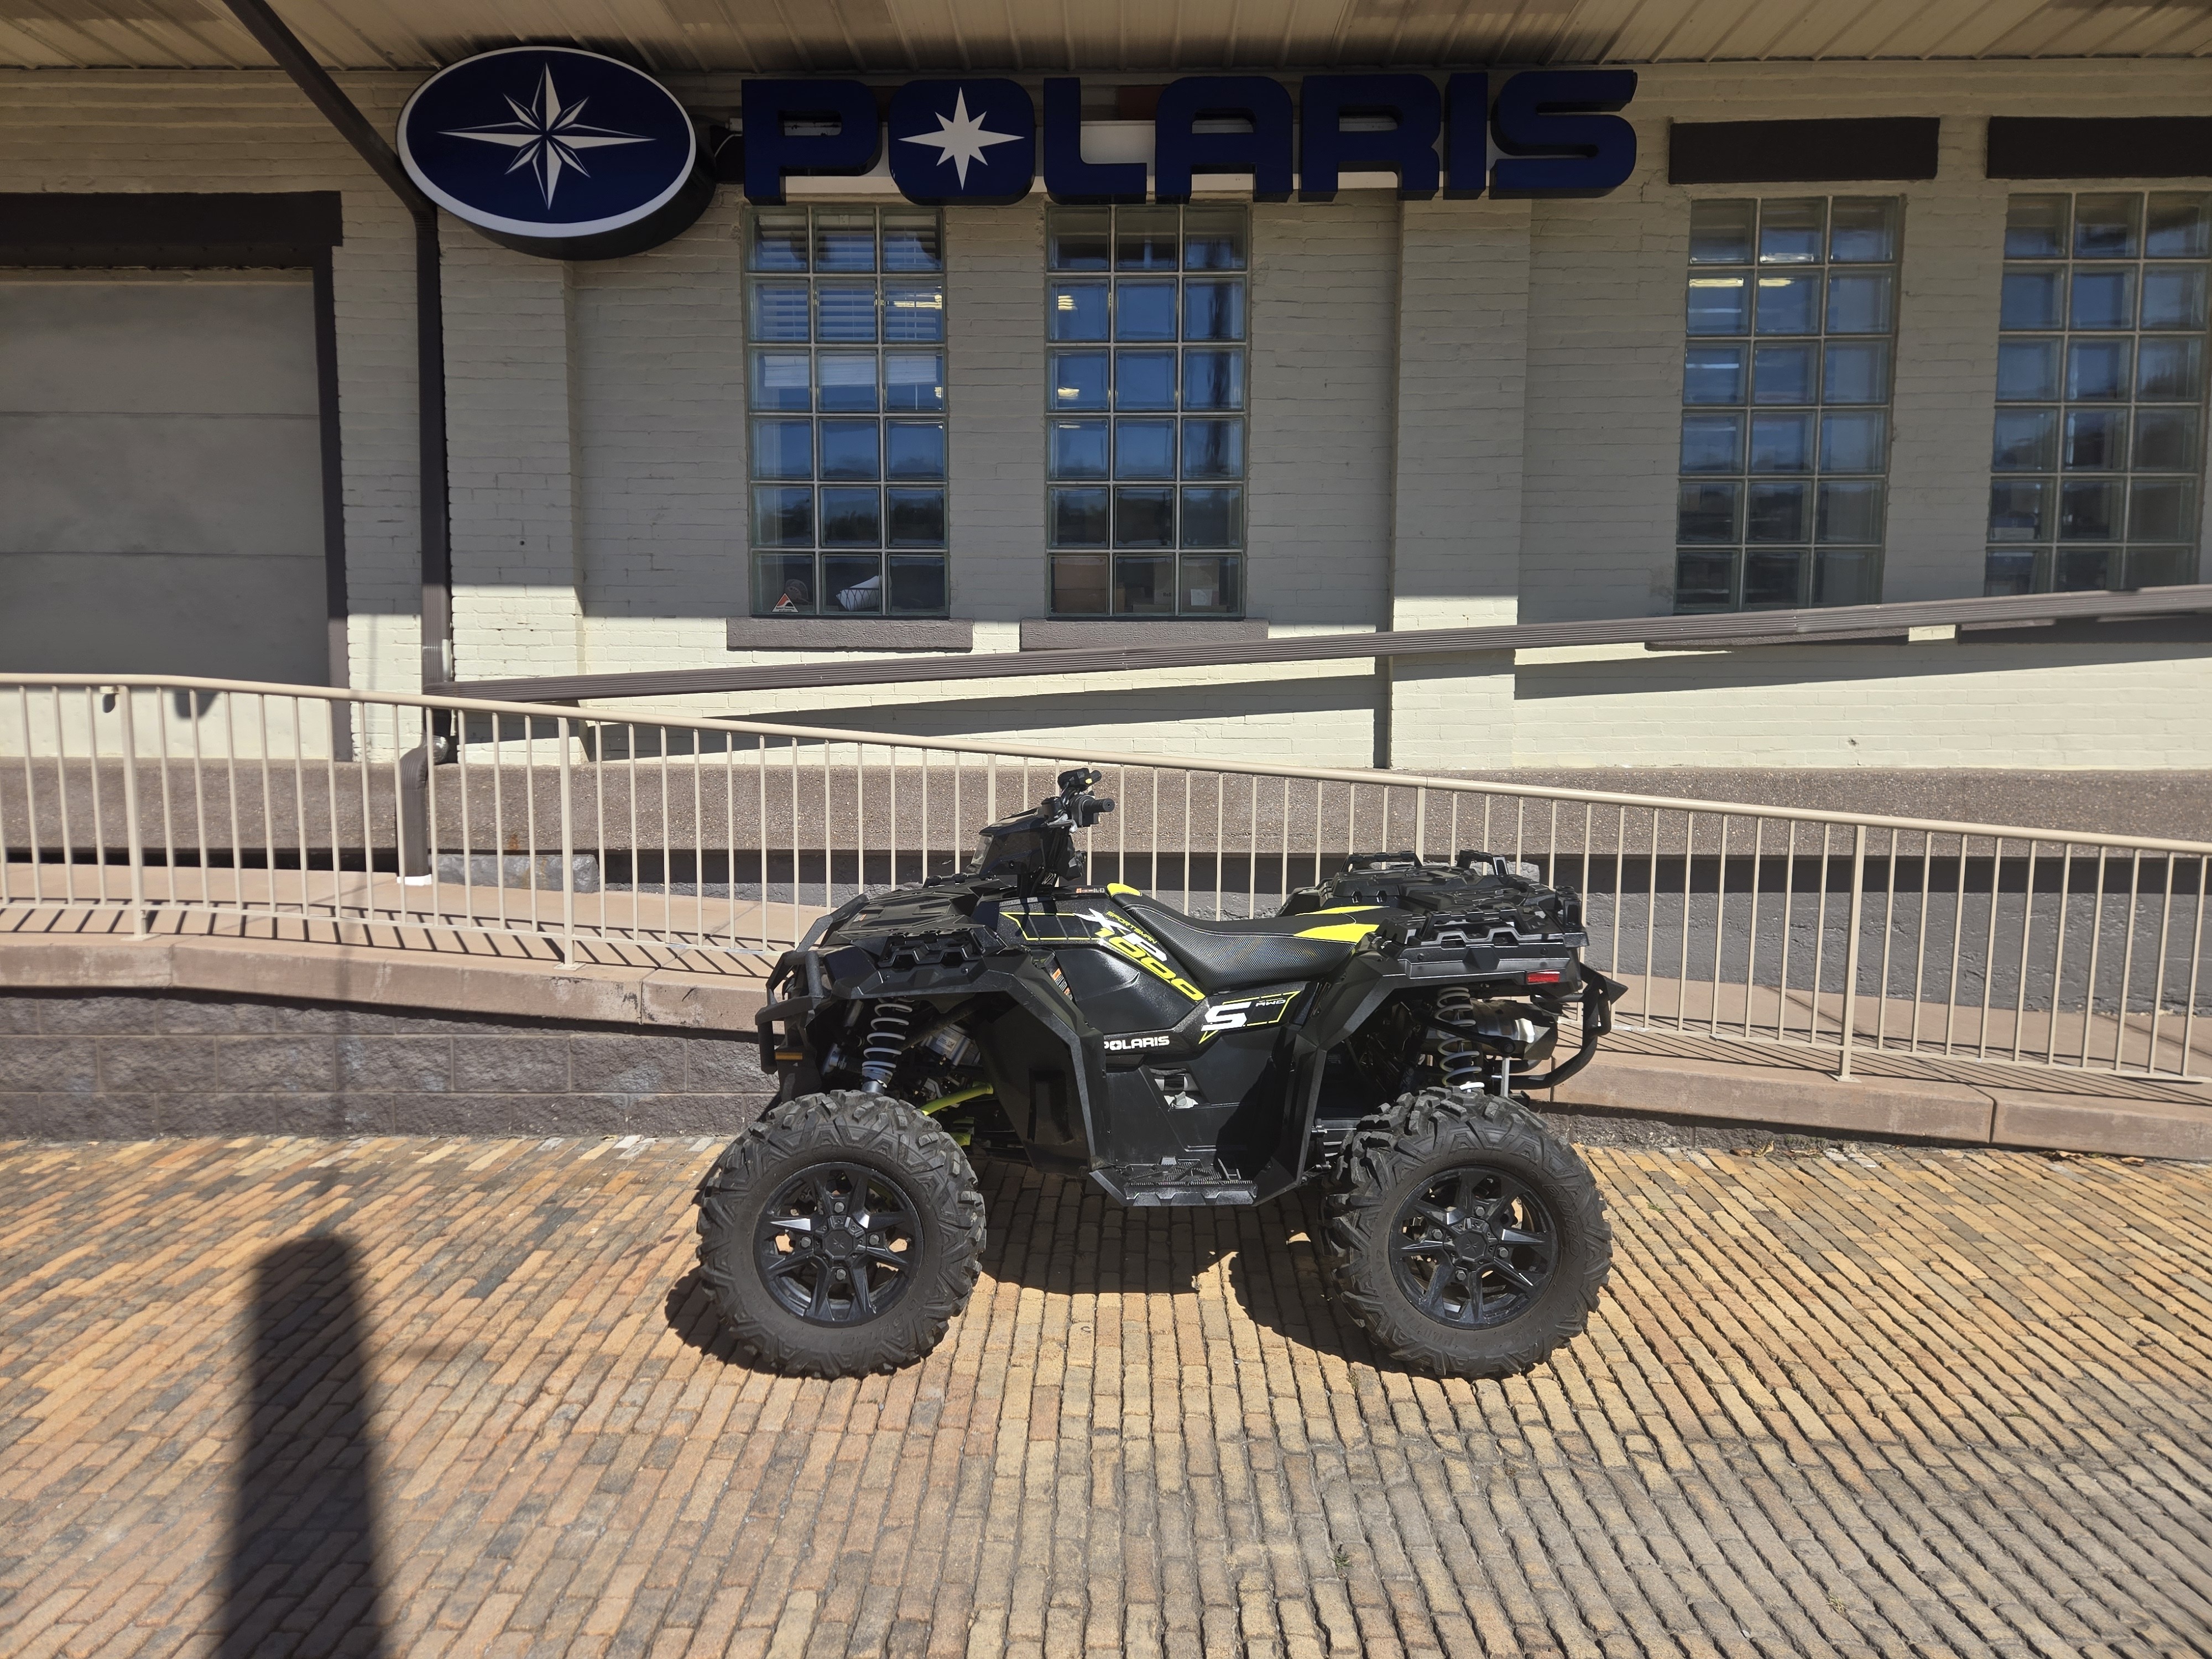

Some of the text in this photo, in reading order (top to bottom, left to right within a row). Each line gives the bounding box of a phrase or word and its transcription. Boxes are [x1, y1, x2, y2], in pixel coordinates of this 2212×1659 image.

[742, 70, 1638, 205] POLARIS
[1072, 908, 1167, 962] XP
[1106, 911, 1158, 945] SPORTSMAN
[1094, 927, 1206, 1001] 1000
[1201, 1001, 1252, 1031] S
